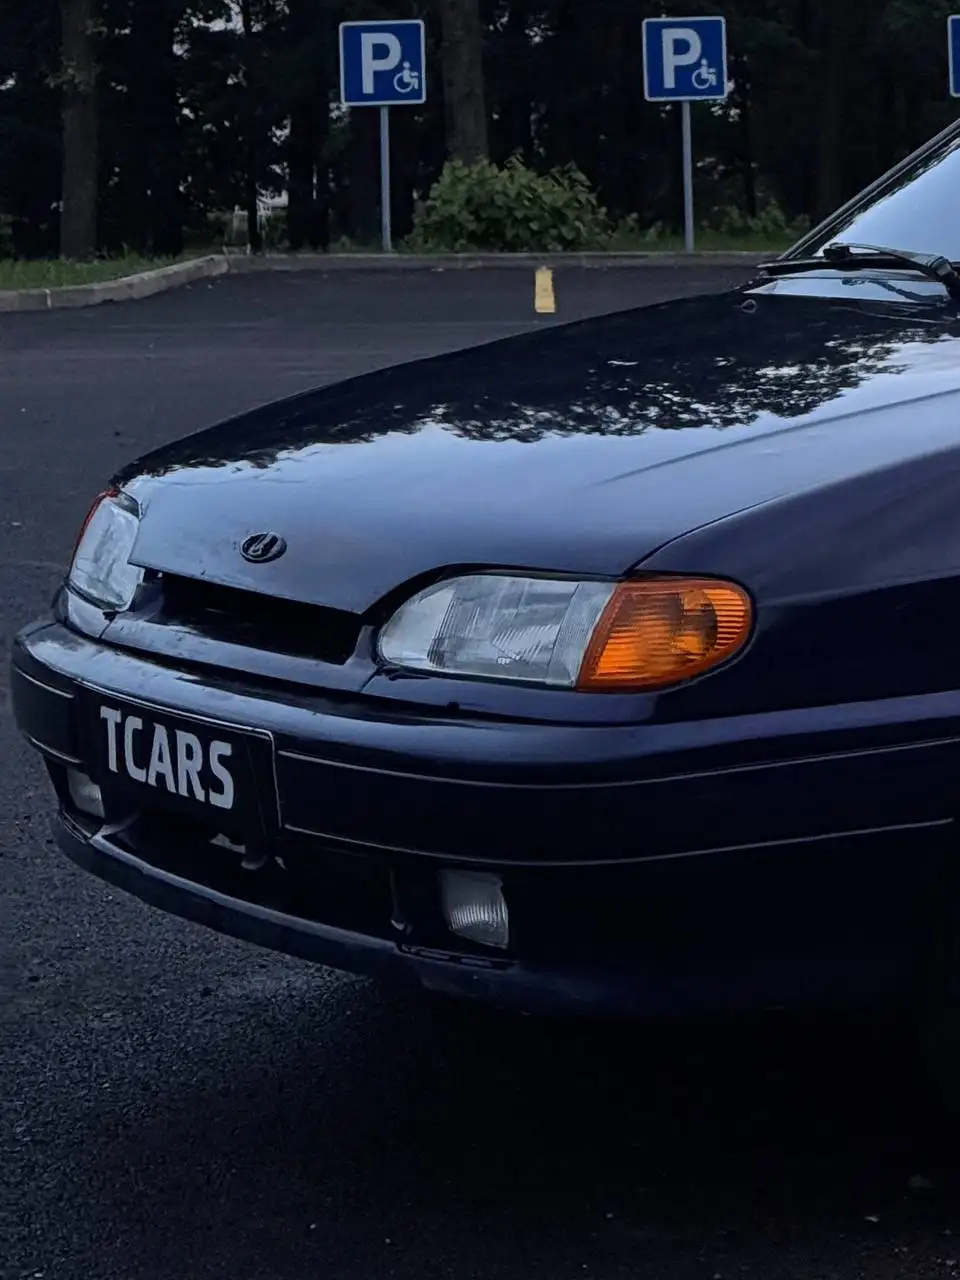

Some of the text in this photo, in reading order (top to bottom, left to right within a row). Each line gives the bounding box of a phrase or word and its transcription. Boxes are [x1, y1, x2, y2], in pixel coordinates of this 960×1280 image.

[361, 32, 402, 94] P
[661, 27, 702, 89] P
[100, 705, 234, 810] TCARS
